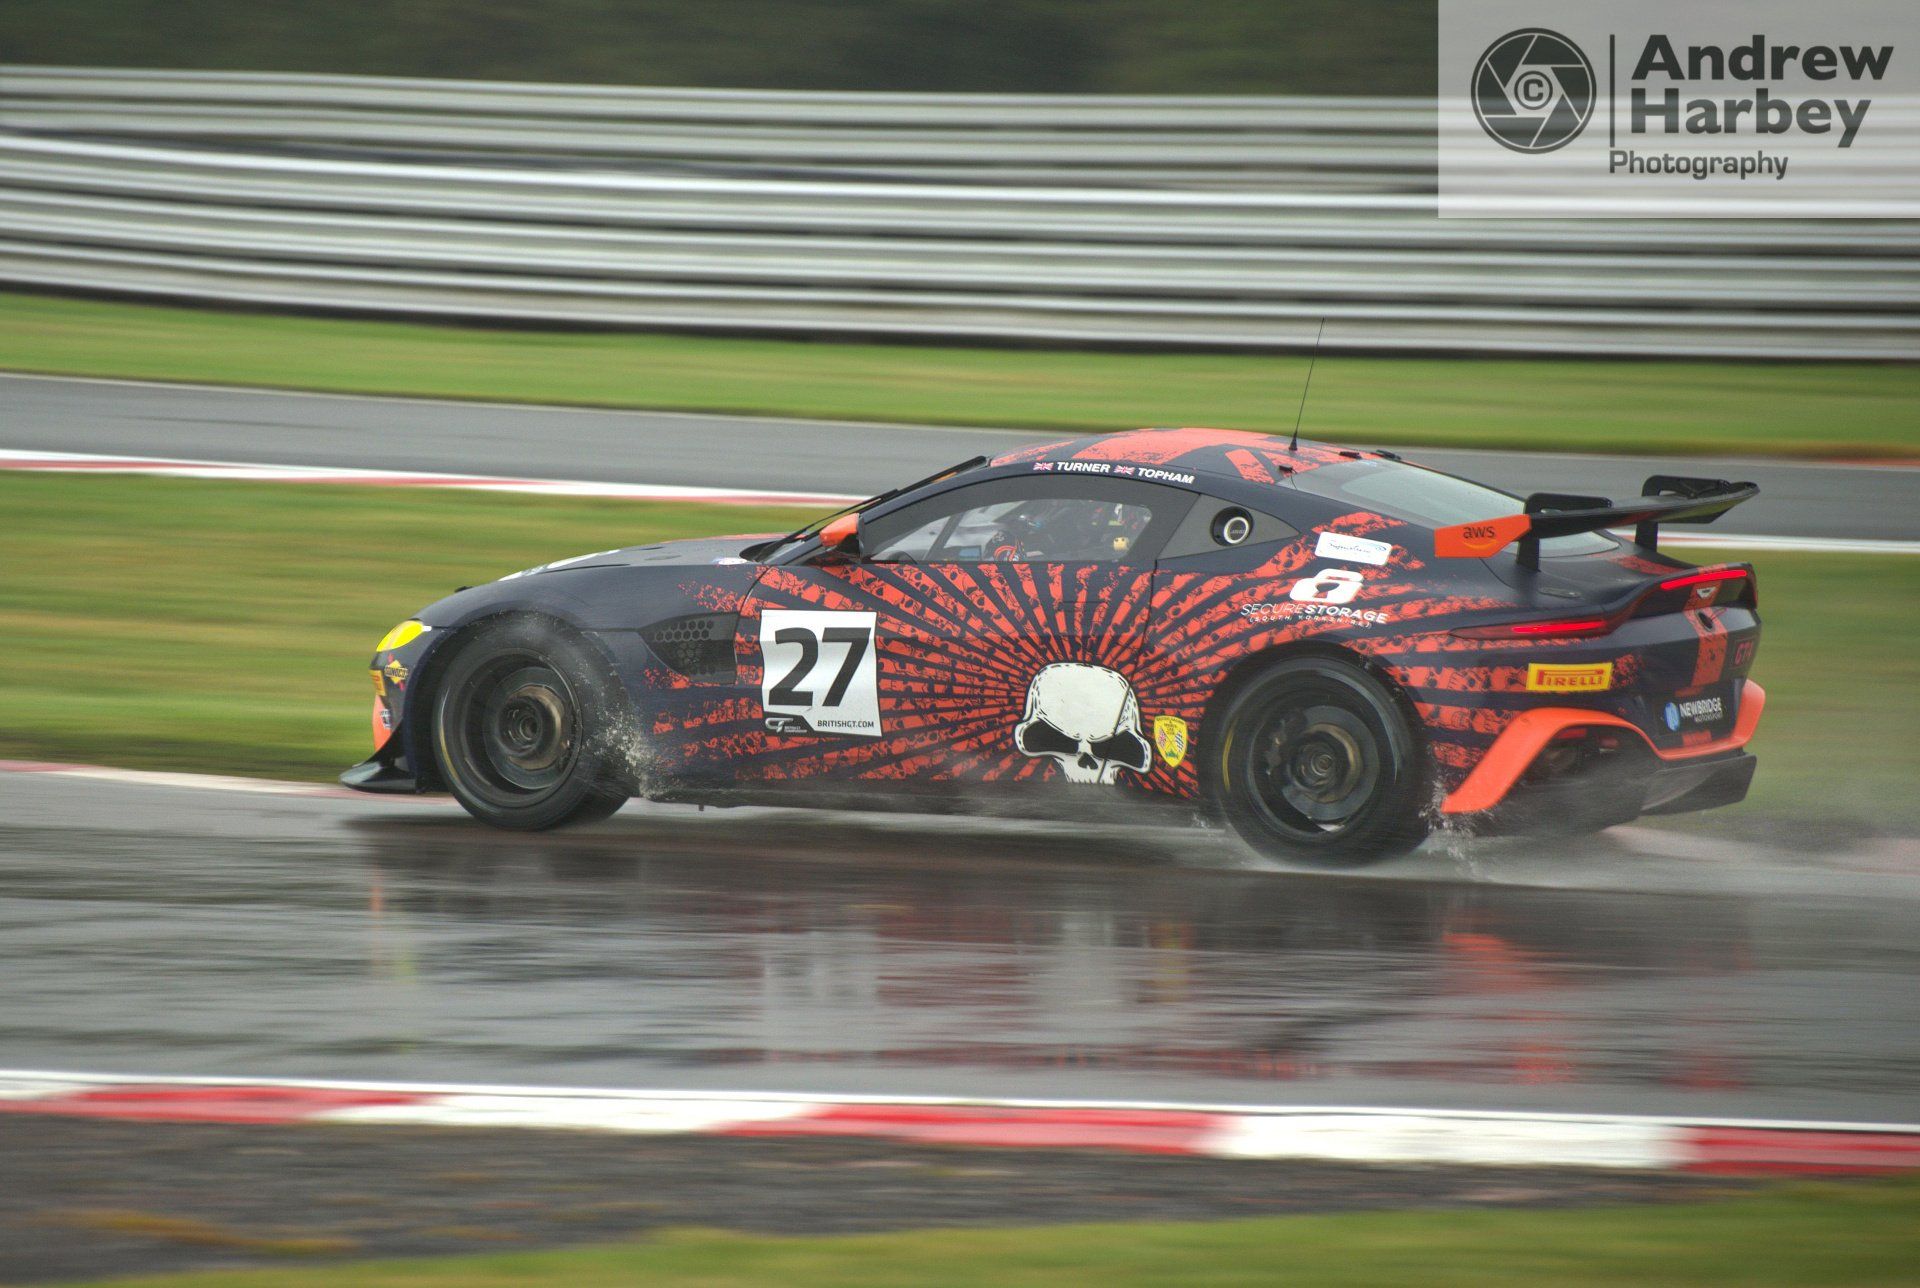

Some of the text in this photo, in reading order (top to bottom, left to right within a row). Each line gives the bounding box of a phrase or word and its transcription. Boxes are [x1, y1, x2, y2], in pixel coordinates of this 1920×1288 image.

[1056, 461, 1111, 473] TURNER
[1138, 467, 1195, 484] TOPHAM
[1462, 526, 1496, 539] aws
[768, 626, 872, 707] 27
[1536, 669, 1604, 687] PIRELLI
[1679, 697, 1721, 718] NEWBRIDGE
[817, 719, 875, 729] BRITISHGT.COM
